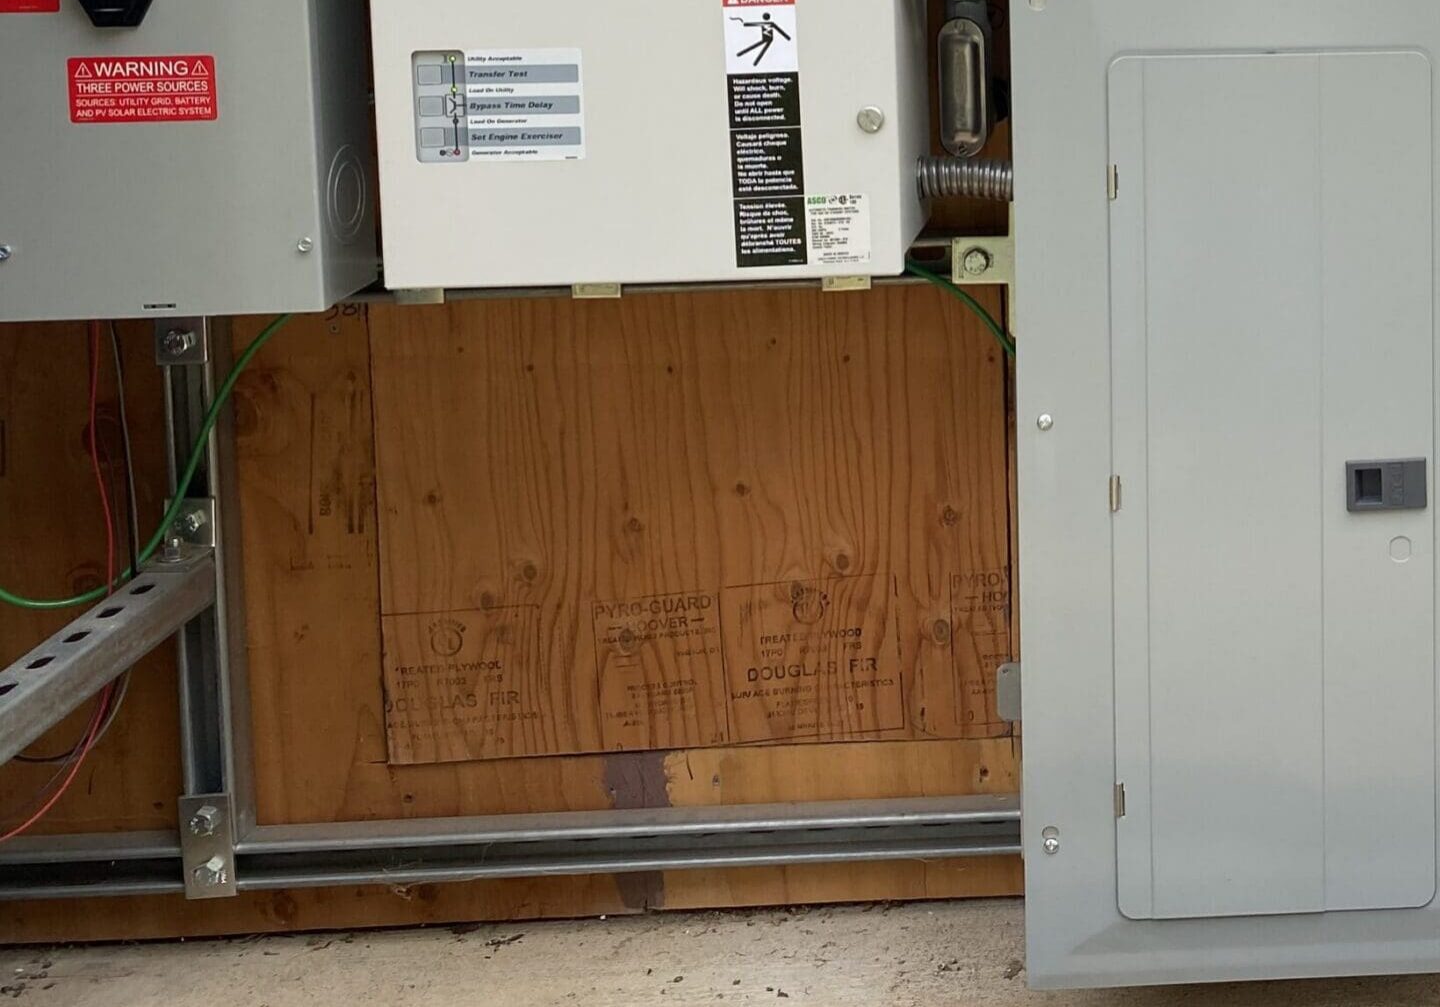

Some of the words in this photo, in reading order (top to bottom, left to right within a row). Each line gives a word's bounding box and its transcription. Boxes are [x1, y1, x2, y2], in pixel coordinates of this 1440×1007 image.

[93, 60, 189, 77] WARNING
[76, 82, 112, 94] THREE
[114, 81, 154, 93] POWER
[156, 80, 209, 92] SOURCES
[119, 98, 149, 106] UTILITY
[175, 96, 211, 105] BATTERY
[469, 102, 502, 111] Bypass
[528, 101, 554, 110] Delay
[76, 109, 94, 118] AND
[95, 109, 107, 117] PV
[108, 109, 136, 117] SOLAR
[137, 108, 177, 116] ELECTRIC
[178, 107, 212, 115] SYSTEM
[488, 133, 519, 142] Engine
[807, 195, 827, 205] ASCO
[594, 594, 712, 620] PYRO-GUARD
[747, 661, 838, 683] DOUGLAS
[849, 657, 878, 674] FIR
[490, 690, 521, 706] FIR
